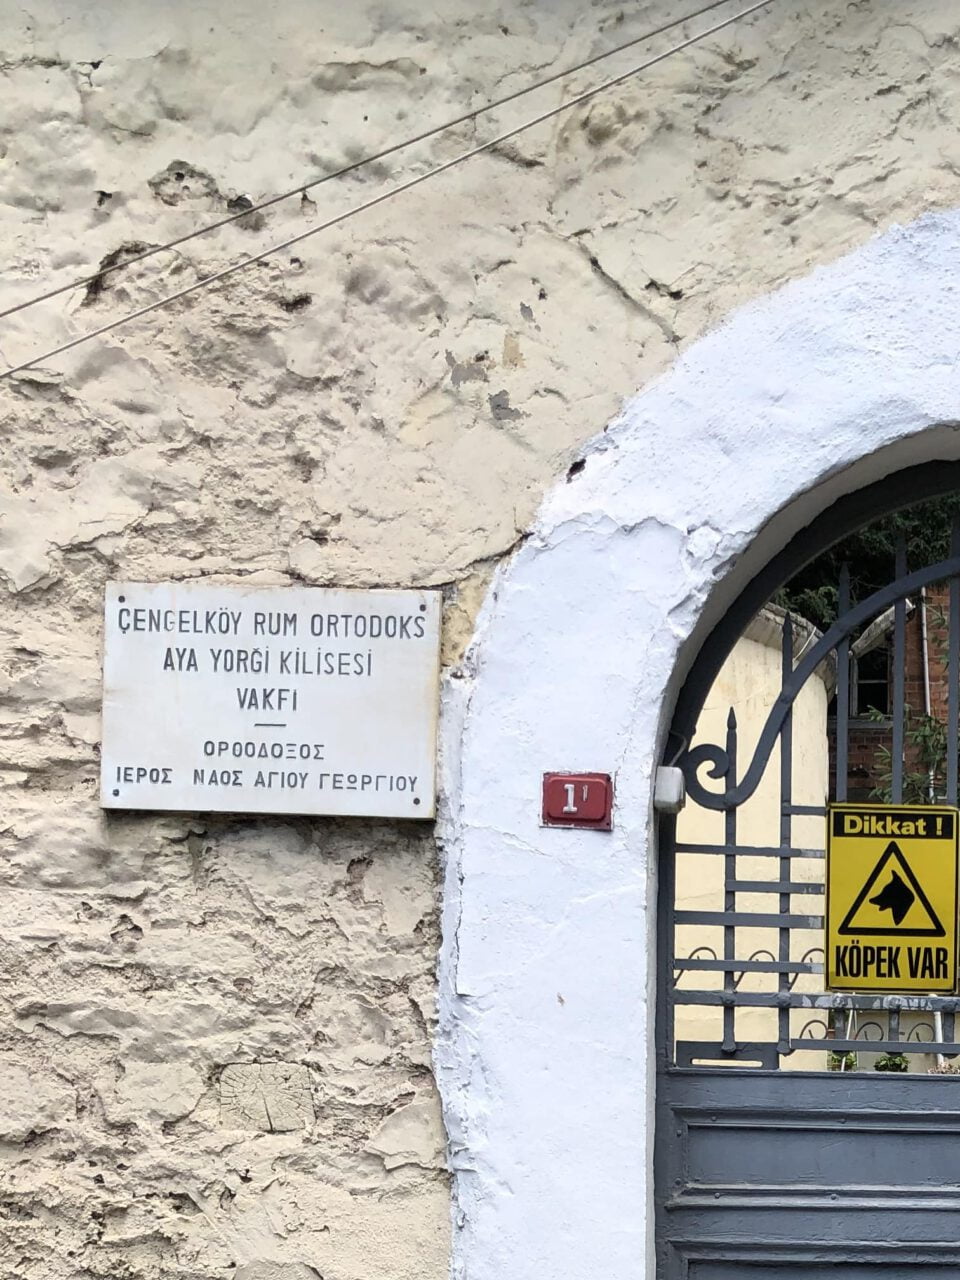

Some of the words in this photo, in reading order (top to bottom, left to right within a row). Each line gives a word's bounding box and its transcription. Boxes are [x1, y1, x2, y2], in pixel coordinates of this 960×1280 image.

[118, 607, 242, 635] ÇENGELKÖY
[253, 612, 298, 636] RUM
[311, 613, 426, 639] ORTODOKS
[163, 647, 198, 672] AYA
[280, 647, 372, 676] KİLİSESİ
[236, 687, 297, 711] VAKFI
[193, 768, 243, 787] ΝΑΟΣ
[254, 771, 308, 790] ΑΓΙΟΥ
[319, 773, 418, 793] ΓΕΩΡΓΙΟΥ
[843, 815, 926, 836] Dikkat
[836, 939, 901, 978] KÖPEK
[907, 946, 948, 979] VAR
